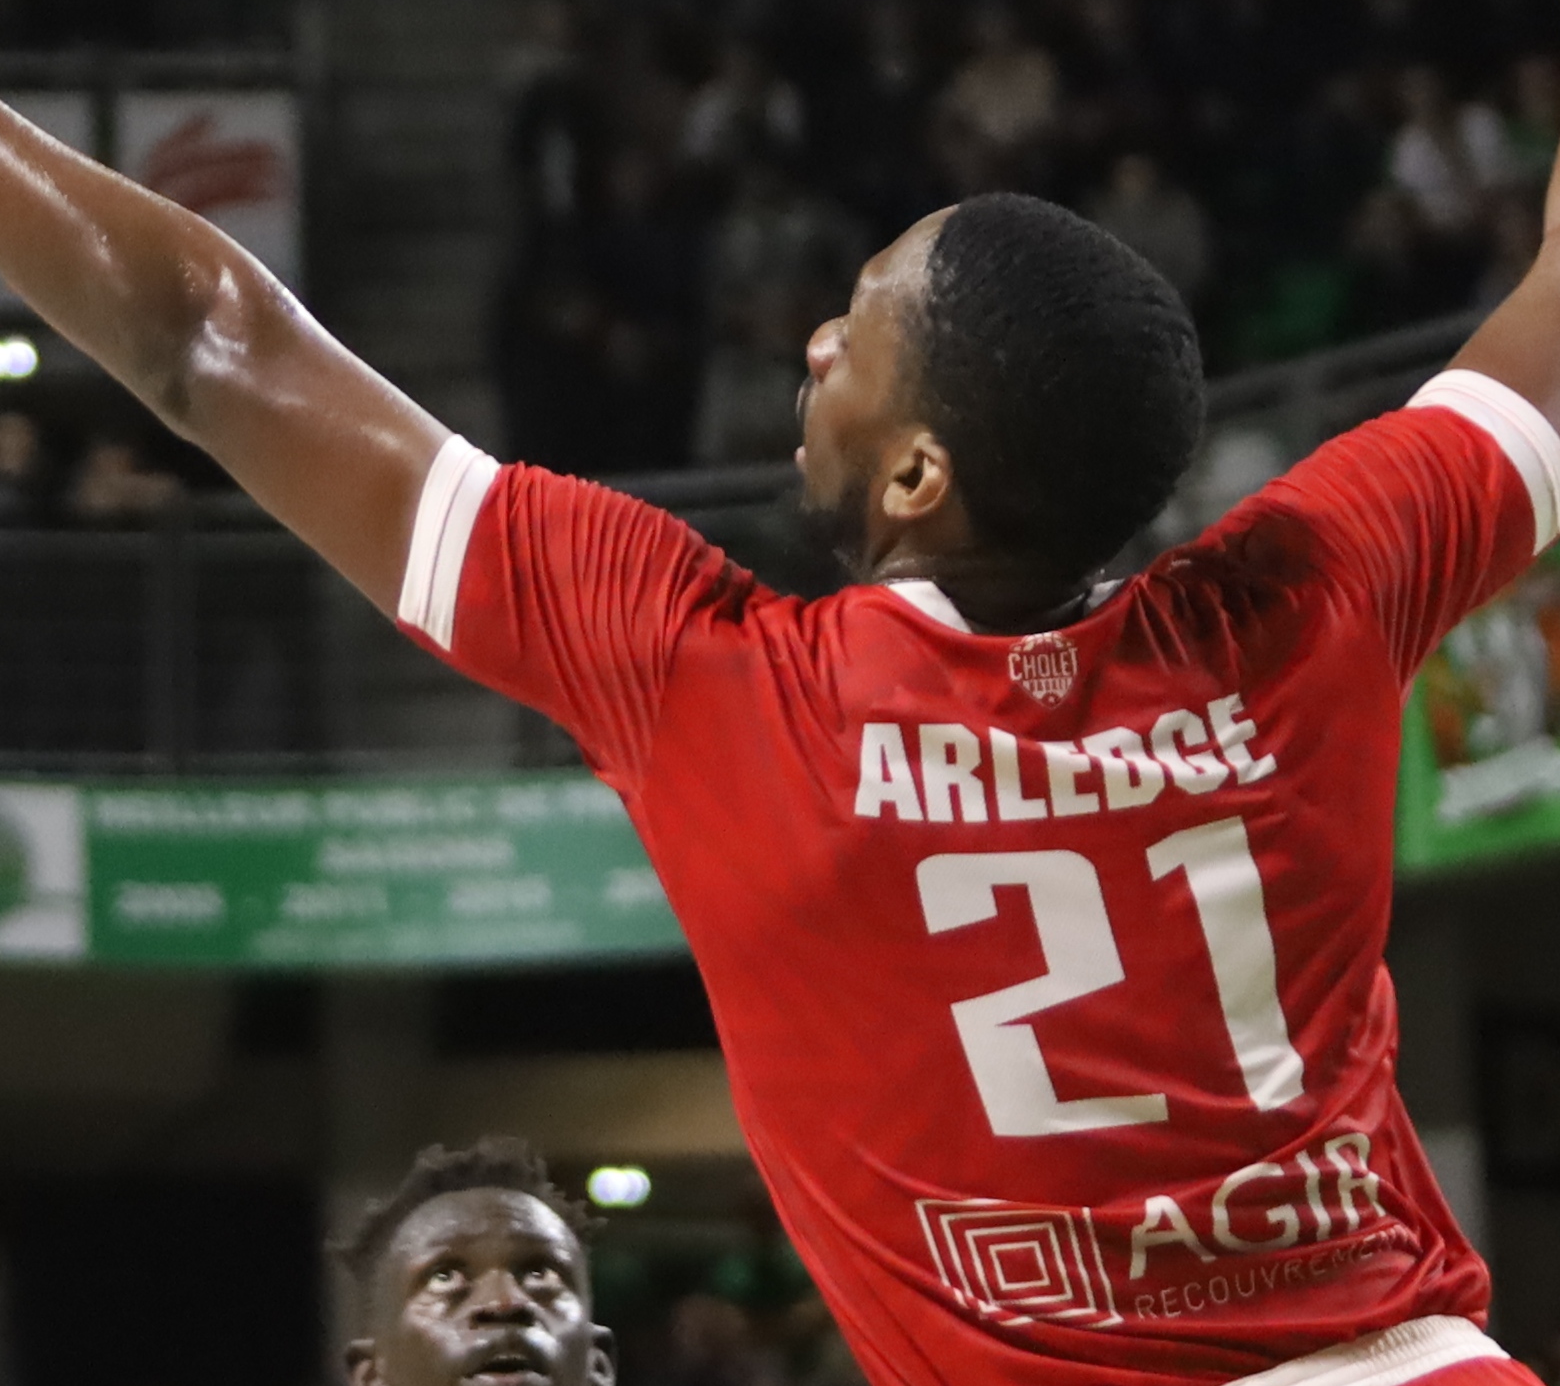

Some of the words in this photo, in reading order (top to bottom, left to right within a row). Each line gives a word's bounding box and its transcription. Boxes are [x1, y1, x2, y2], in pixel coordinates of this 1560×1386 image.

[1008, 646, 1078, 681] CHOLET
[854, 692, 1277, 824] ARLEDGE
[916, 816, 1306, 1137] 21
[1130, 1132, 1386, 1280] AGIR
